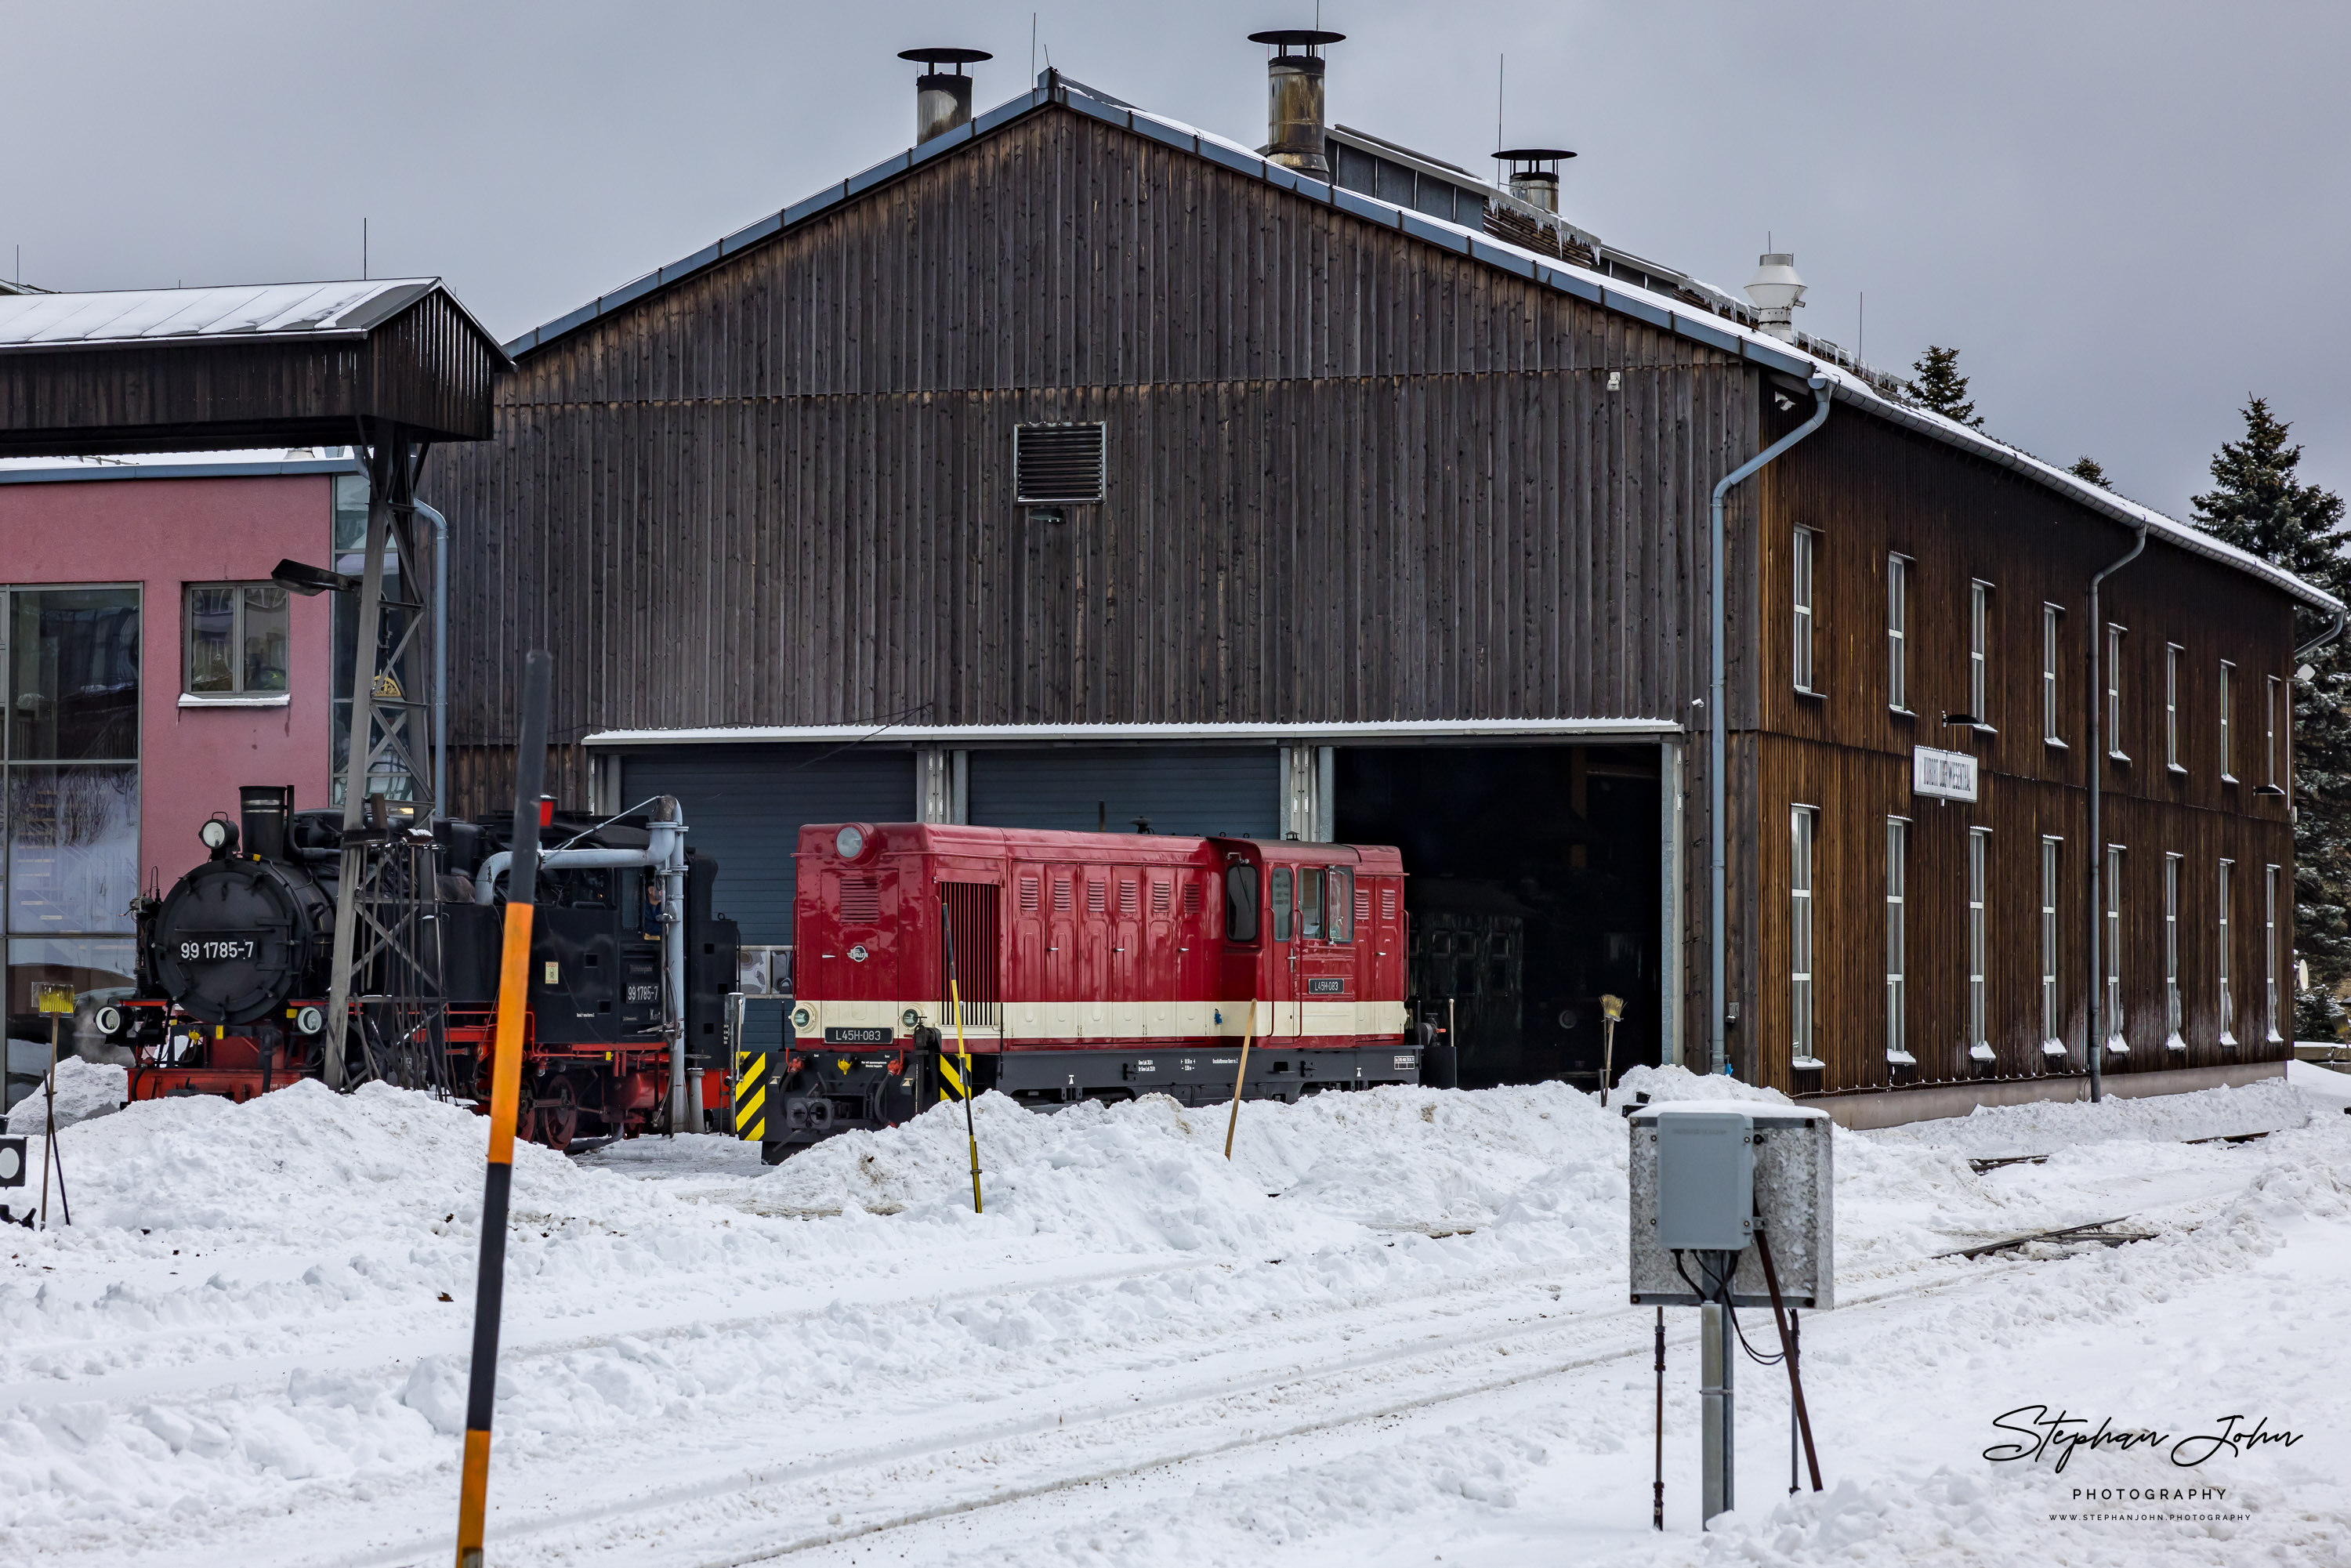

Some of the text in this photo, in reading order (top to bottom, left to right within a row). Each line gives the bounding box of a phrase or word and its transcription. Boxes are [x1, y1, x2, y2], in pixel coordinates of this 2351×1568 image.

[180, 941, 254, 959] 99 1785-7
[1314, 981, 1339, 991] L45H-083
[628, 985, 658, 1001] 99 1785-7
[835, 1030, 881, 1041] L45H-083
